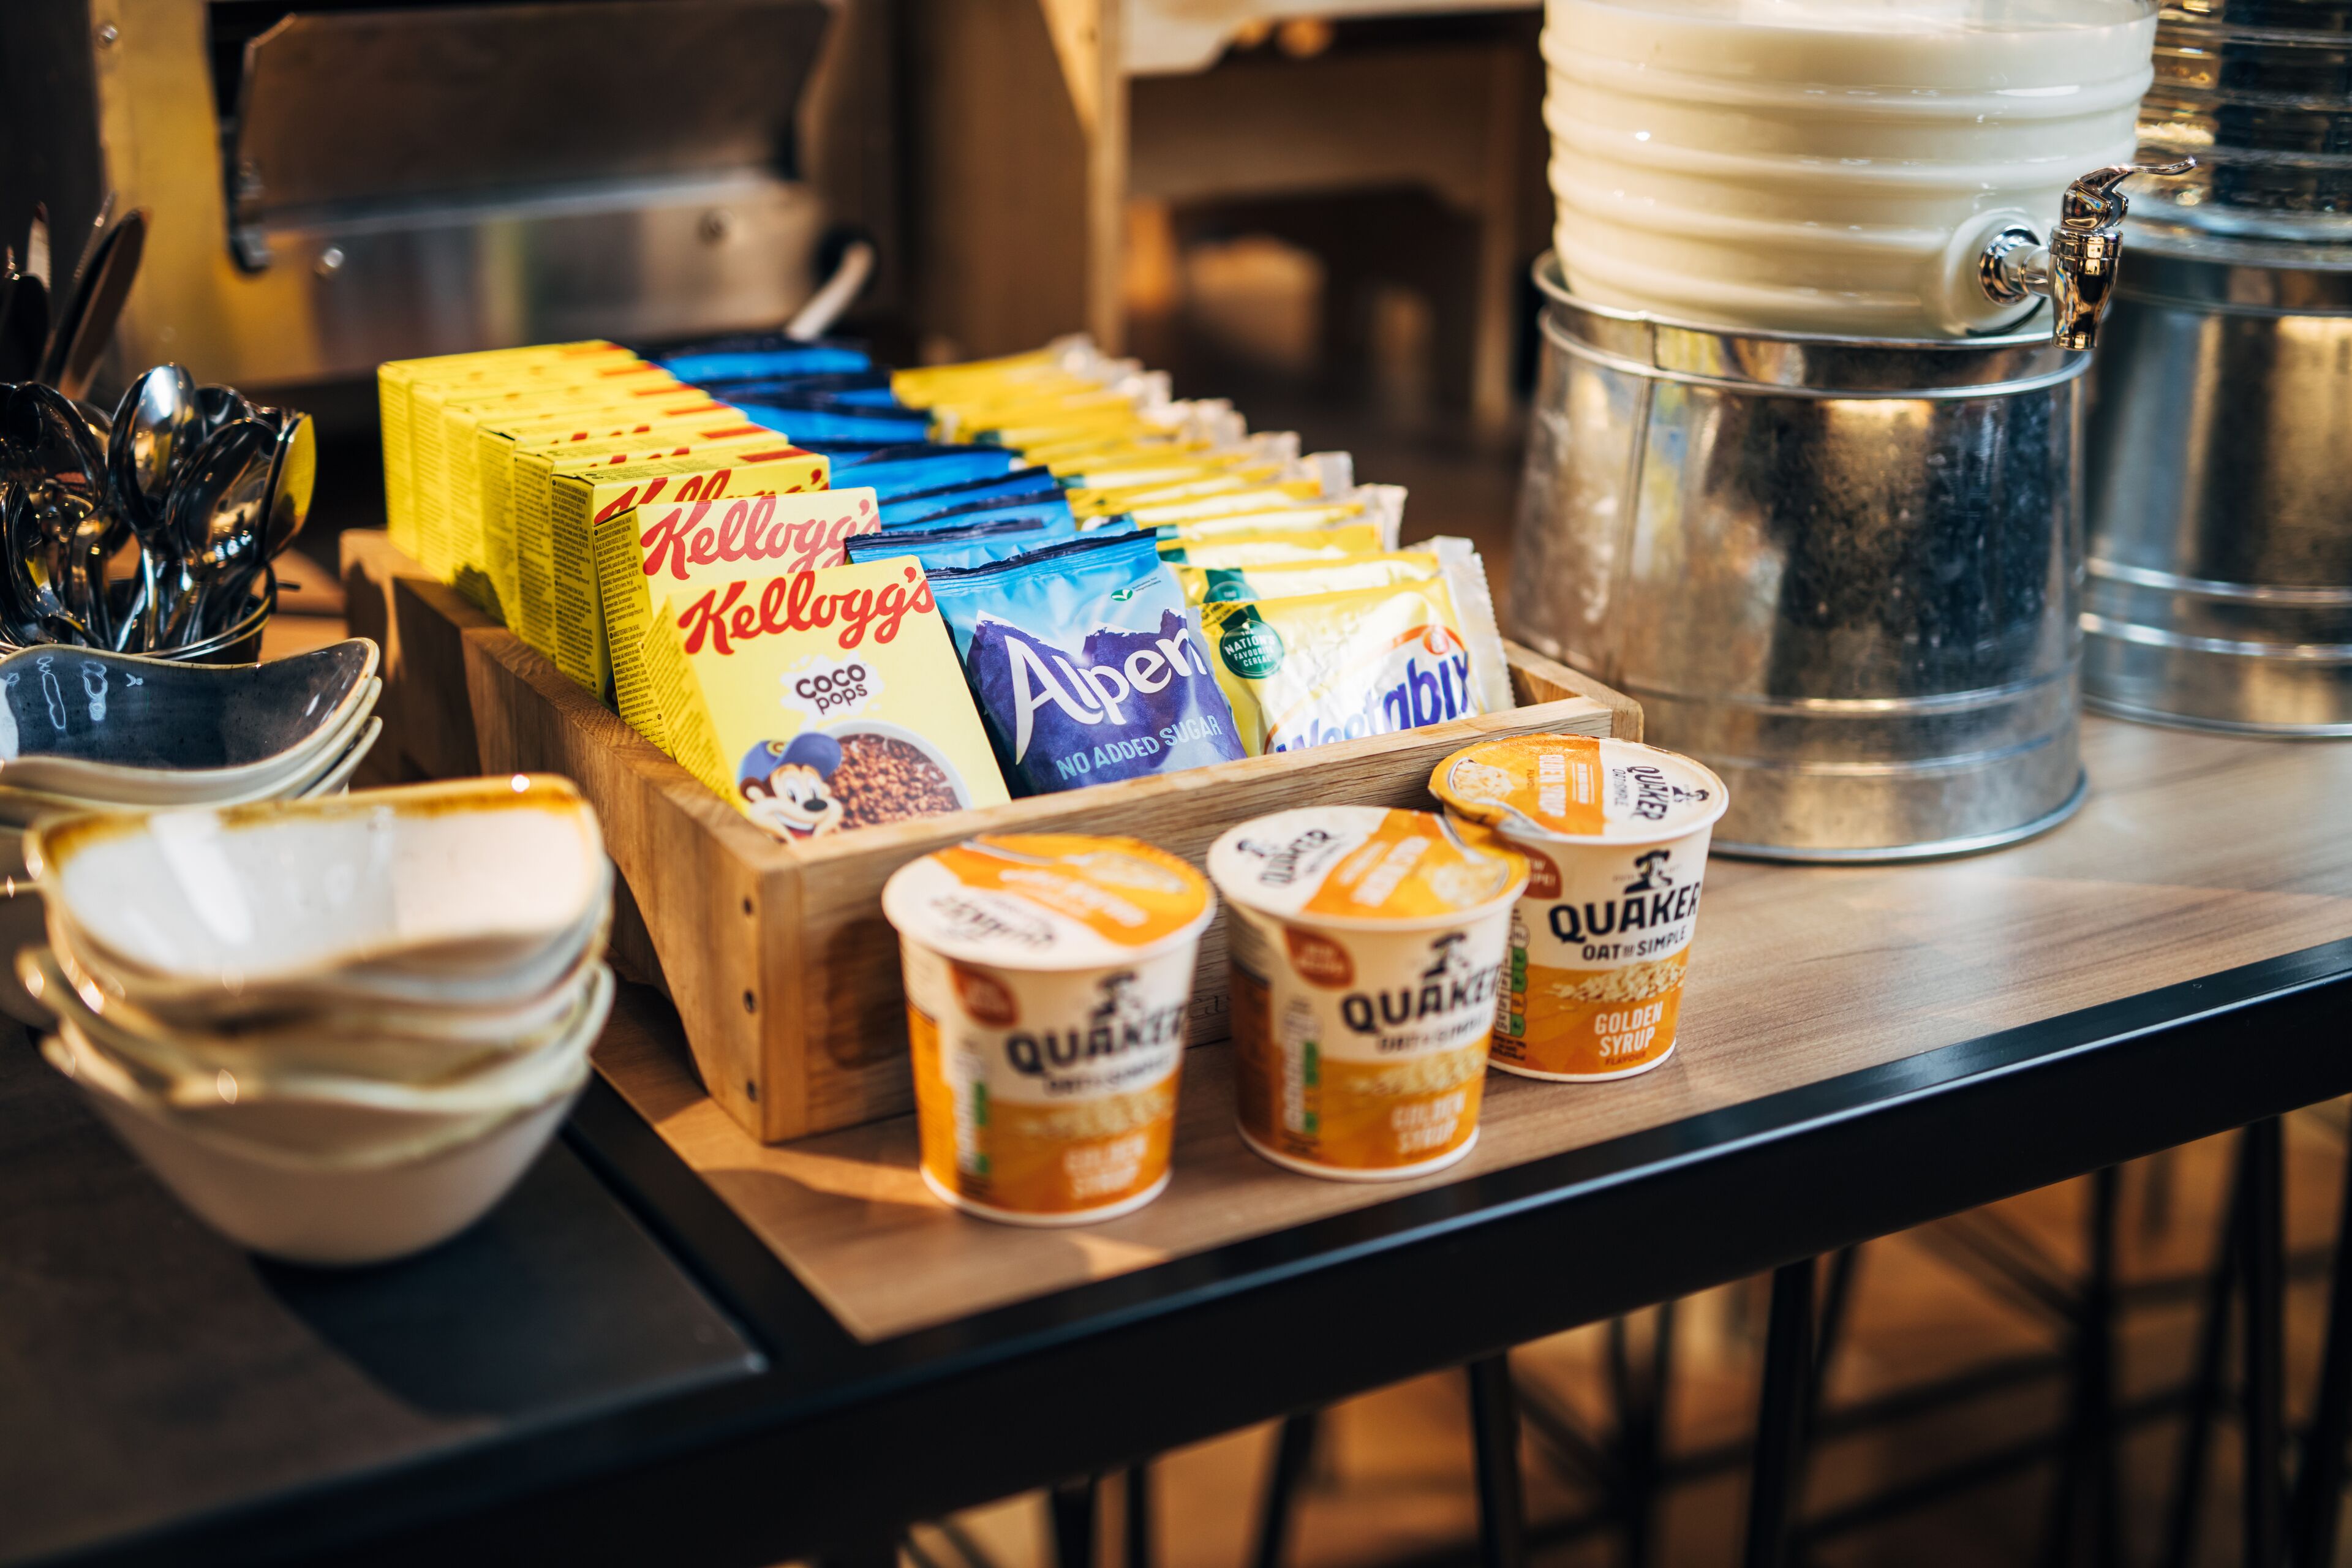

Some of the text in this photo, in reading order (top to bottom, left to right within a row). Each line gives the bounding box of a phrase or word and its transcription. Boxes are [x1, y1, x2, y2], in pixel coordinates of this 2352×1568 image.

[677, 567, 935, 655] Kellogg's
[1224, 635, 1275, 655] NATION'S
[1234, 645, 1275, 661] FAVOURITE
[1243, 655, 1272, 667] CEREAL
[796, 665, 866, 698] coco
[1005, 628, 1207, 765] Alpen
[815, 684, 868, 715] pops
[1055, 714, 1223, 780] NO ADDED SUGAR
[1627, 766, 1669, 820] QUAKER
[1549, 881, 1700, 944] QUAKER
[1582, 944, 1621, 960] OAT
[1637, 925, 1686, 957] SIMPLE
[1594, 1000, 1664, 1036] GOLDEN
[1599, 1027, 1656, 1057] SYRUP
